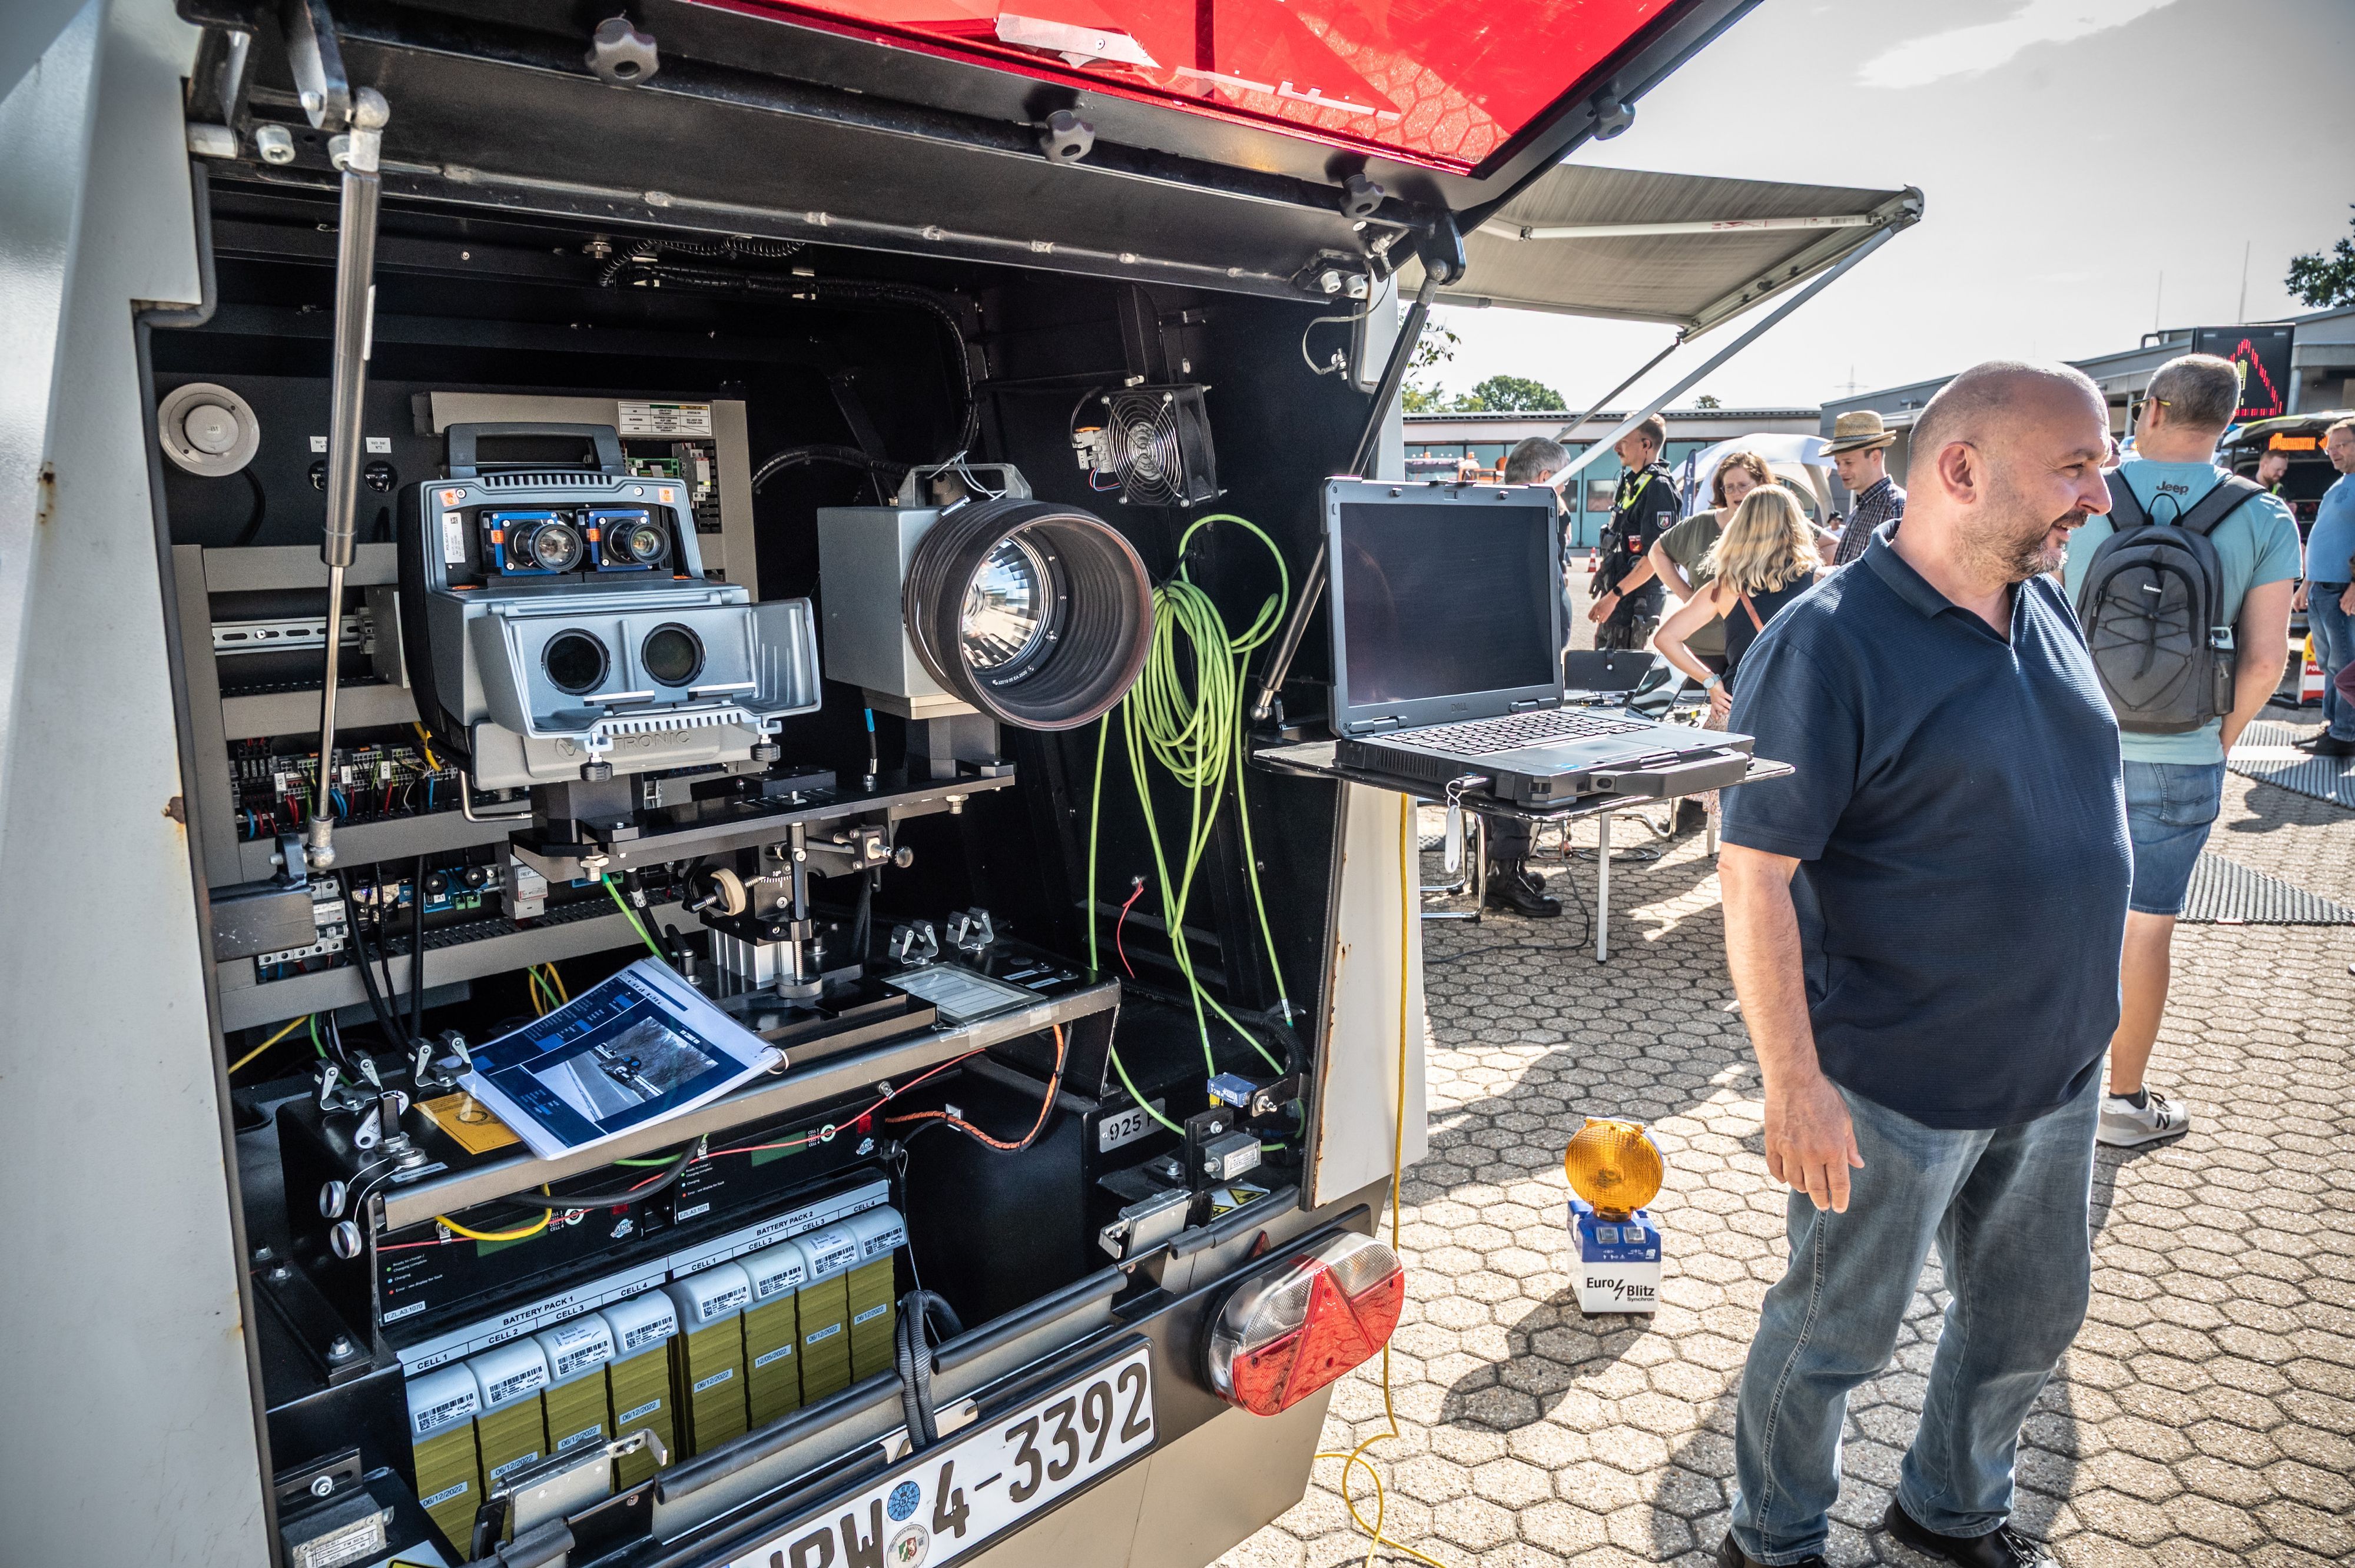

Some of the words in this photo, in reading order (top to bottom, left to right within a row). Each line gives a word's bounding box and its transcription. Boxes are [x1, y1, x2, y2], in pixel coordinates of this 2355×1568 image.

[2156, 481, 2189, 496] Jeep
[612, 730, 690, 751] TRONIC
[1110, 1114, 1142, 1141] 925
[854, 1202, 870, 1212] CELL
[757, 1220, 788, 1236] BATTERY
[790, 1215, 808, 1224] PACK
[802, 1221, 820, 1231] CELL
[748, 1240, 767, 1250] CELL
[691, 1260, 711, 1271] CELL
[621, 1285, 641, 1297] CELL
[1587, 1277, 1614, 1288] Euro
[1627, 1285, 1655, 1297] Blitz
[386, 1304, 423, 1320] EZL.A3.1070
[503, 1306, 542, 1326] BATTERY
[545, 1299, 568, 1311] PACK
[556, 1308, 578, 1320] CELL
[489, 1331, 512, 1344] CELL
[809, 1326, 838, 1342] 06/12/2022
[417, 1357, 441, 1370] CELL
[757, 1348, 787, 1366] 12/05/2022
[697, 1371, 729, 1390] 06/12/2022
[622, 1402, 656, 1421] 06/12/2022
[561, 1427, 597, 1447] 06/12/2022
[931, 1362, 1151, 1539] 4-3392
[495, 1455, 533, 1476] 06/12/2022
[423, 1484, 463, 1507] 06/12/2022
